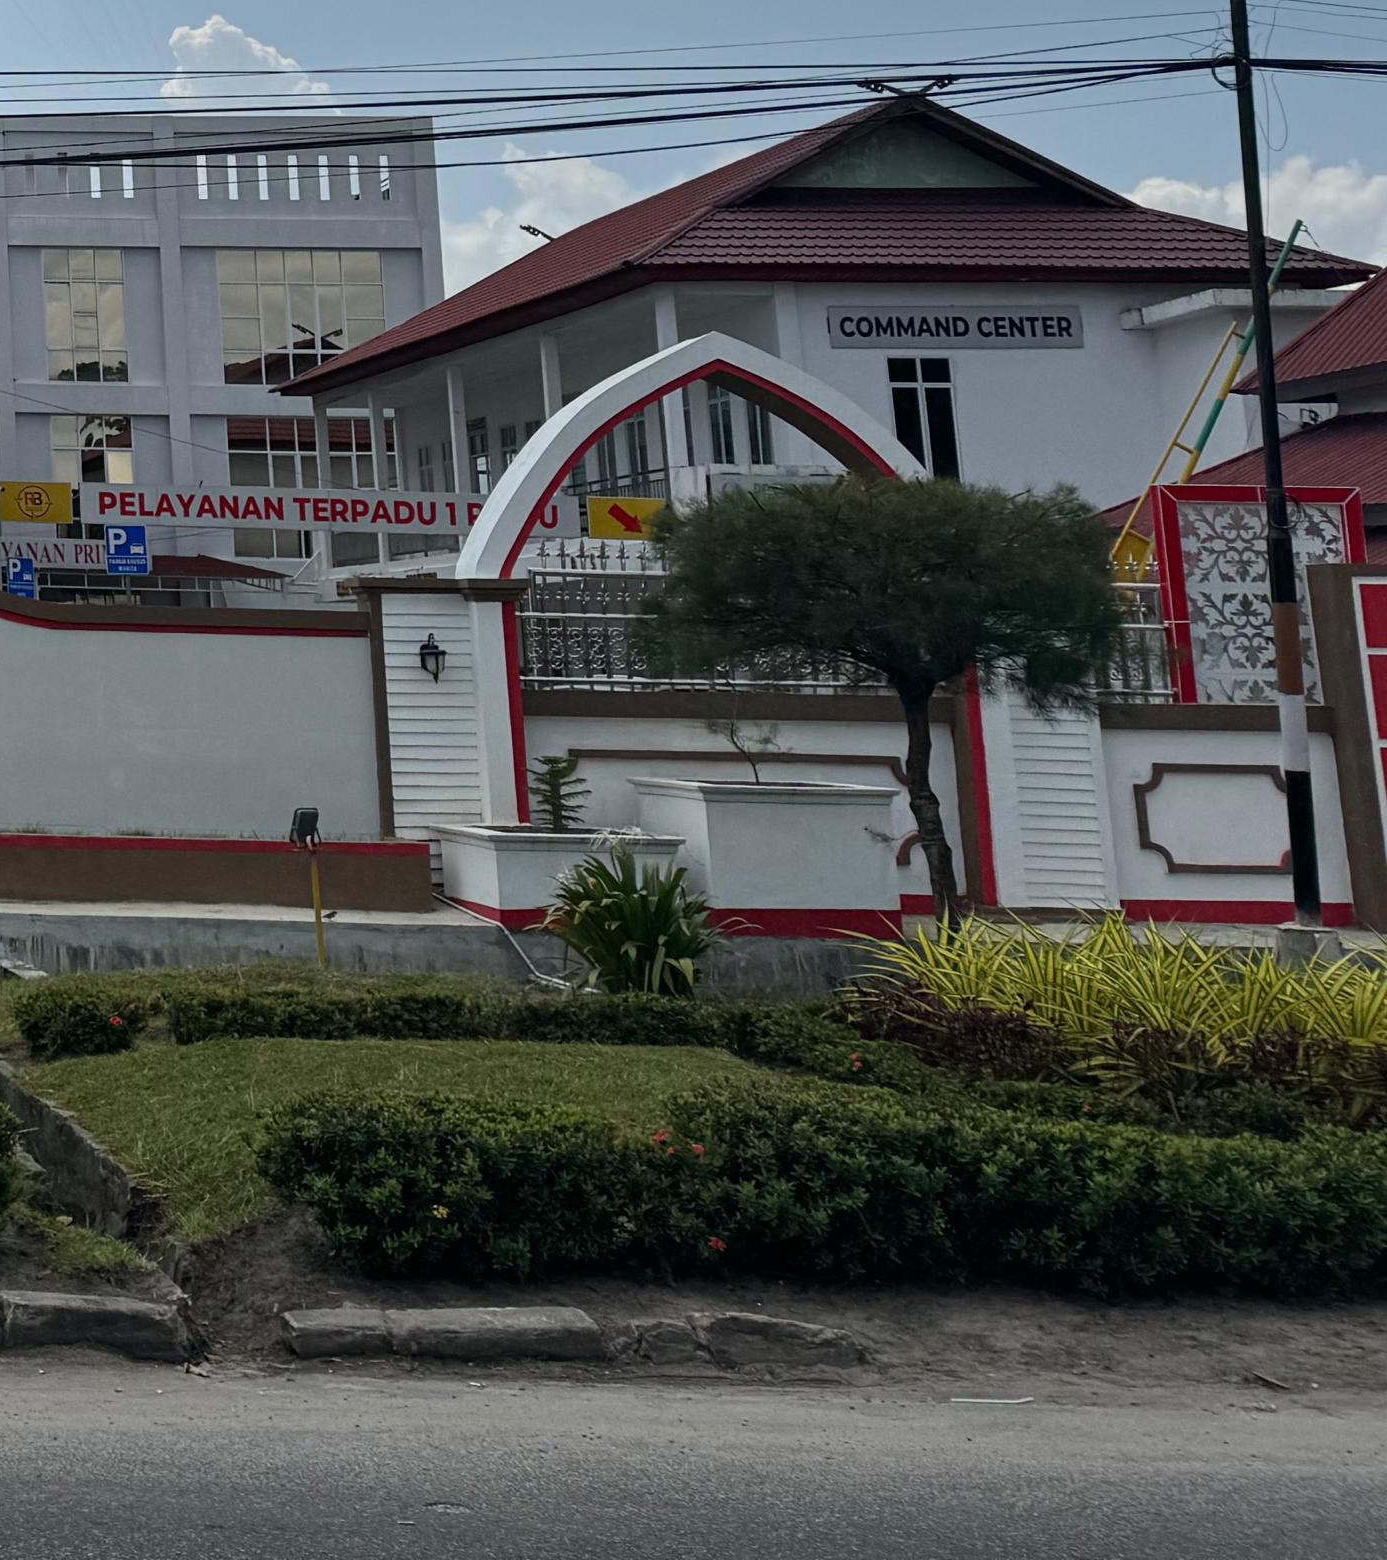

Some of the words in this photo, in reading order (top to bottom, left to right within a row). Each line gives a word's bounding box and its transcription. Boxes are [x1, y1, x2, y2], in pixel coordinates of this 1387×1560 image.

[839, 315, 970, 338] COMMAND
[977, 315, 1073, 338] CENTER
[98, 491, 284, 521] PELAYANAN
[293, 497, 438, 526] TERPADU
[445, 502, 457, 527] 1
[108, 528, 127, 555] P
[74, 543, 106, 565] PRI
[9, 558, 22, 581] P
